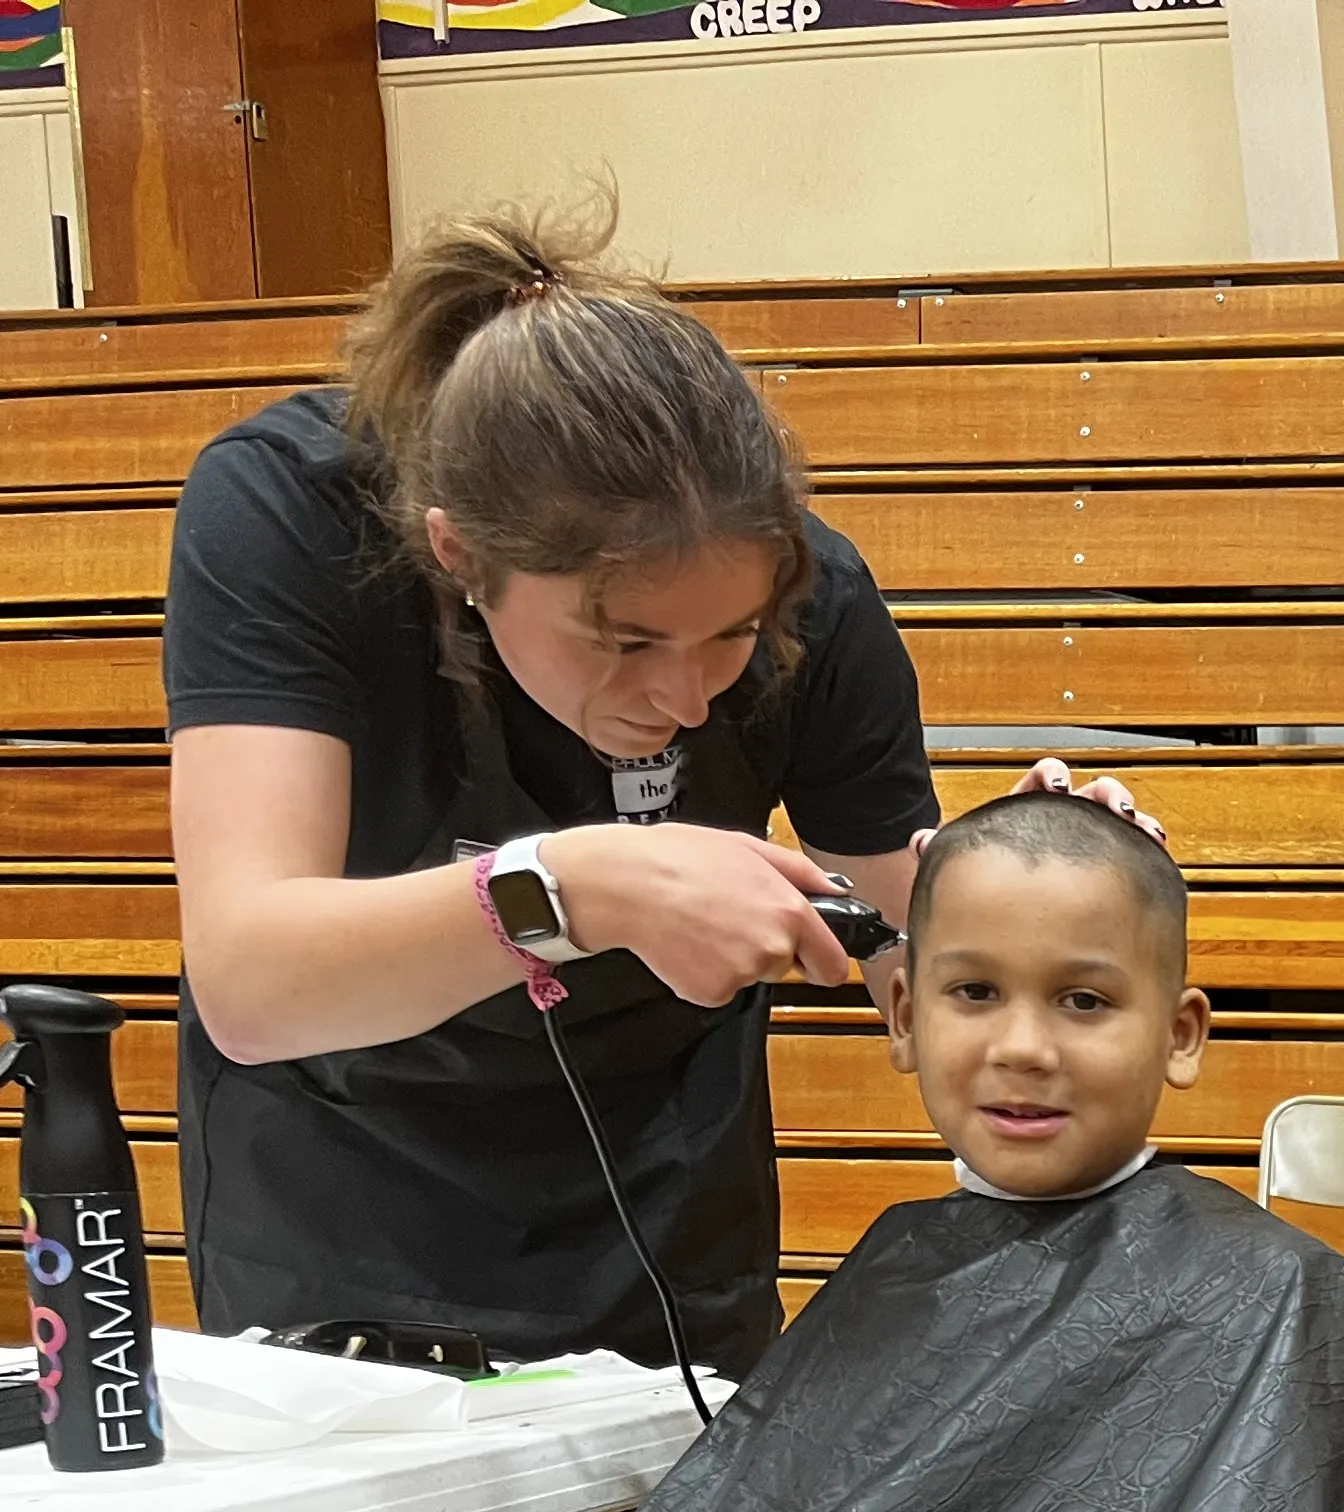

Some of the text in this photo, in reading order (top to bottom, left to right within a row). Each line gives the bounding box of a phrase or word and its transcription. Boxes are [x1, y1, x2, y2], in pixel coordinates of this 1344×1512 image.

[690, 0, 821, 38] CREEP
[639, 779, 669, 800] the
[77, 1208, 146, 1452] FRAMAR
